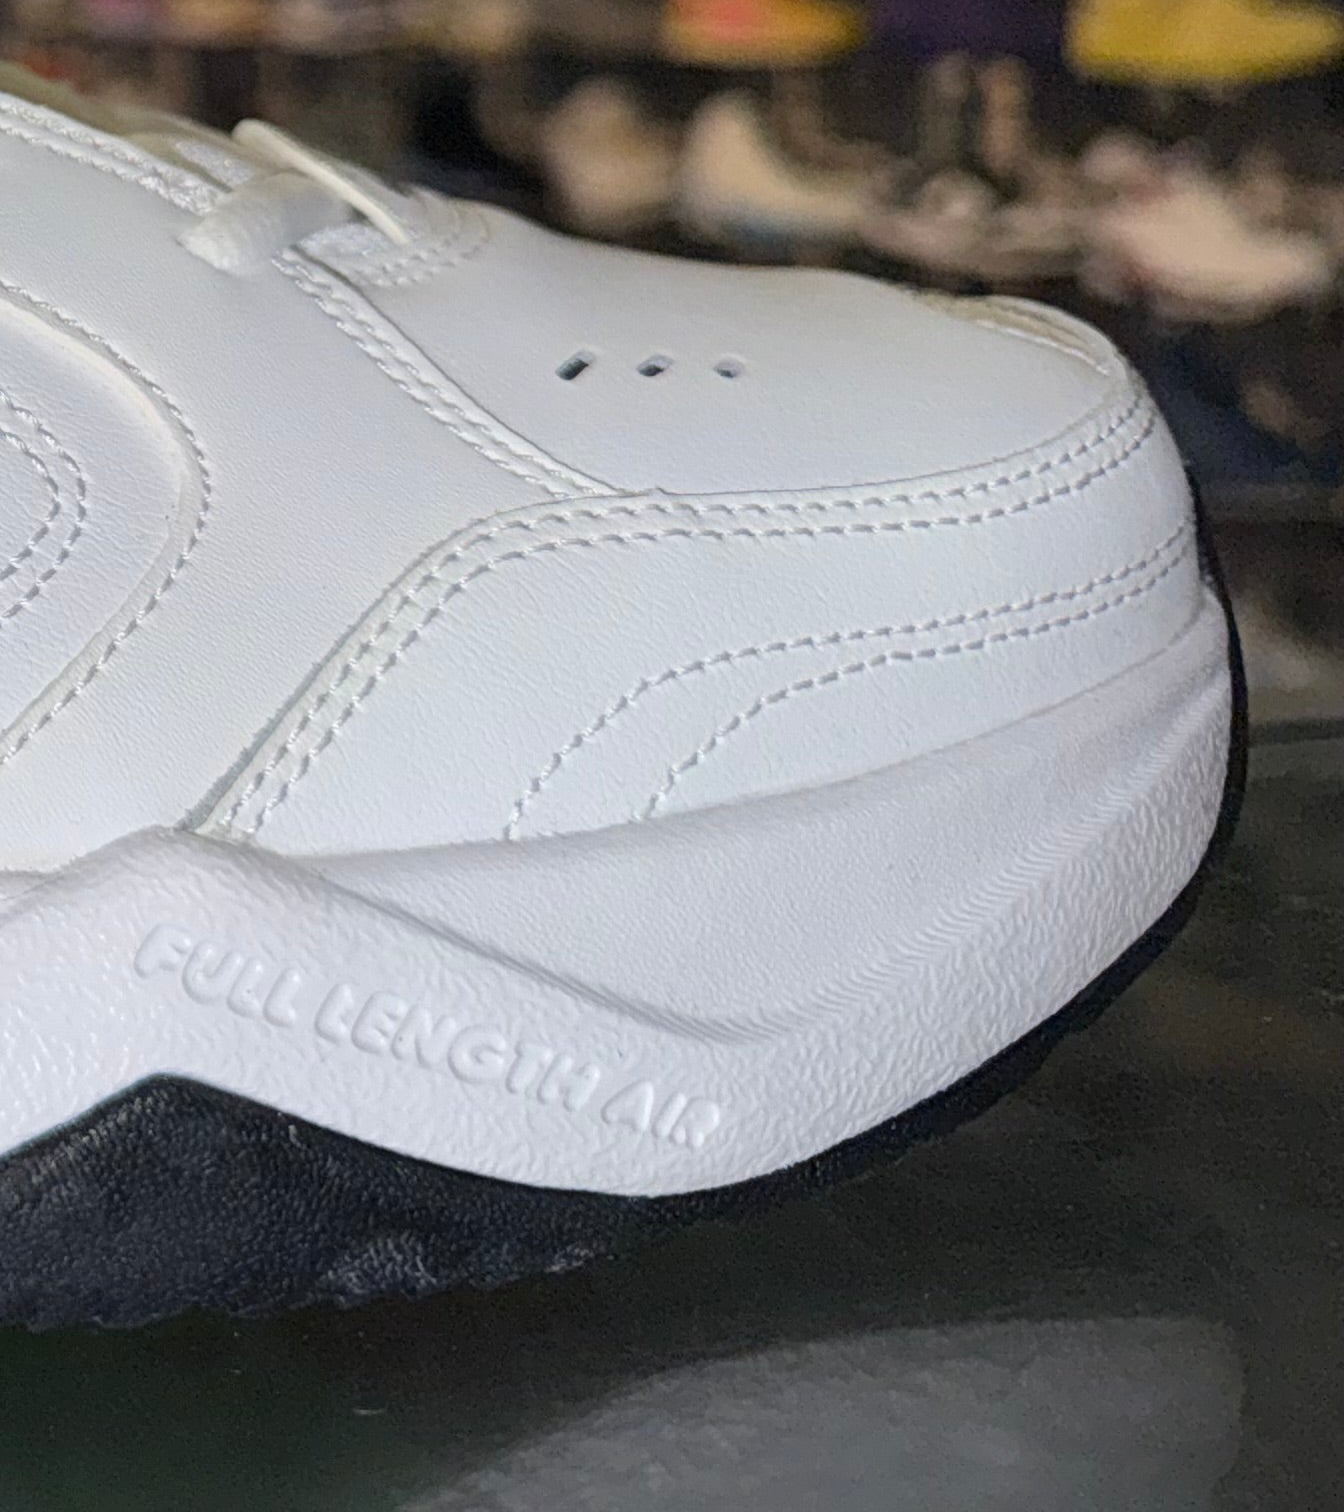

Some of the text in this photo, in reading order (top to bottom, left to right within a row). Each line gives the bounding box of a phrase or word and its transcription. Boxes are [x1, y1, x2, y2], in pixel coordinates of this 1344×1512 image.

[133, 922, 721, 1150] FULL LENGTH AIR
